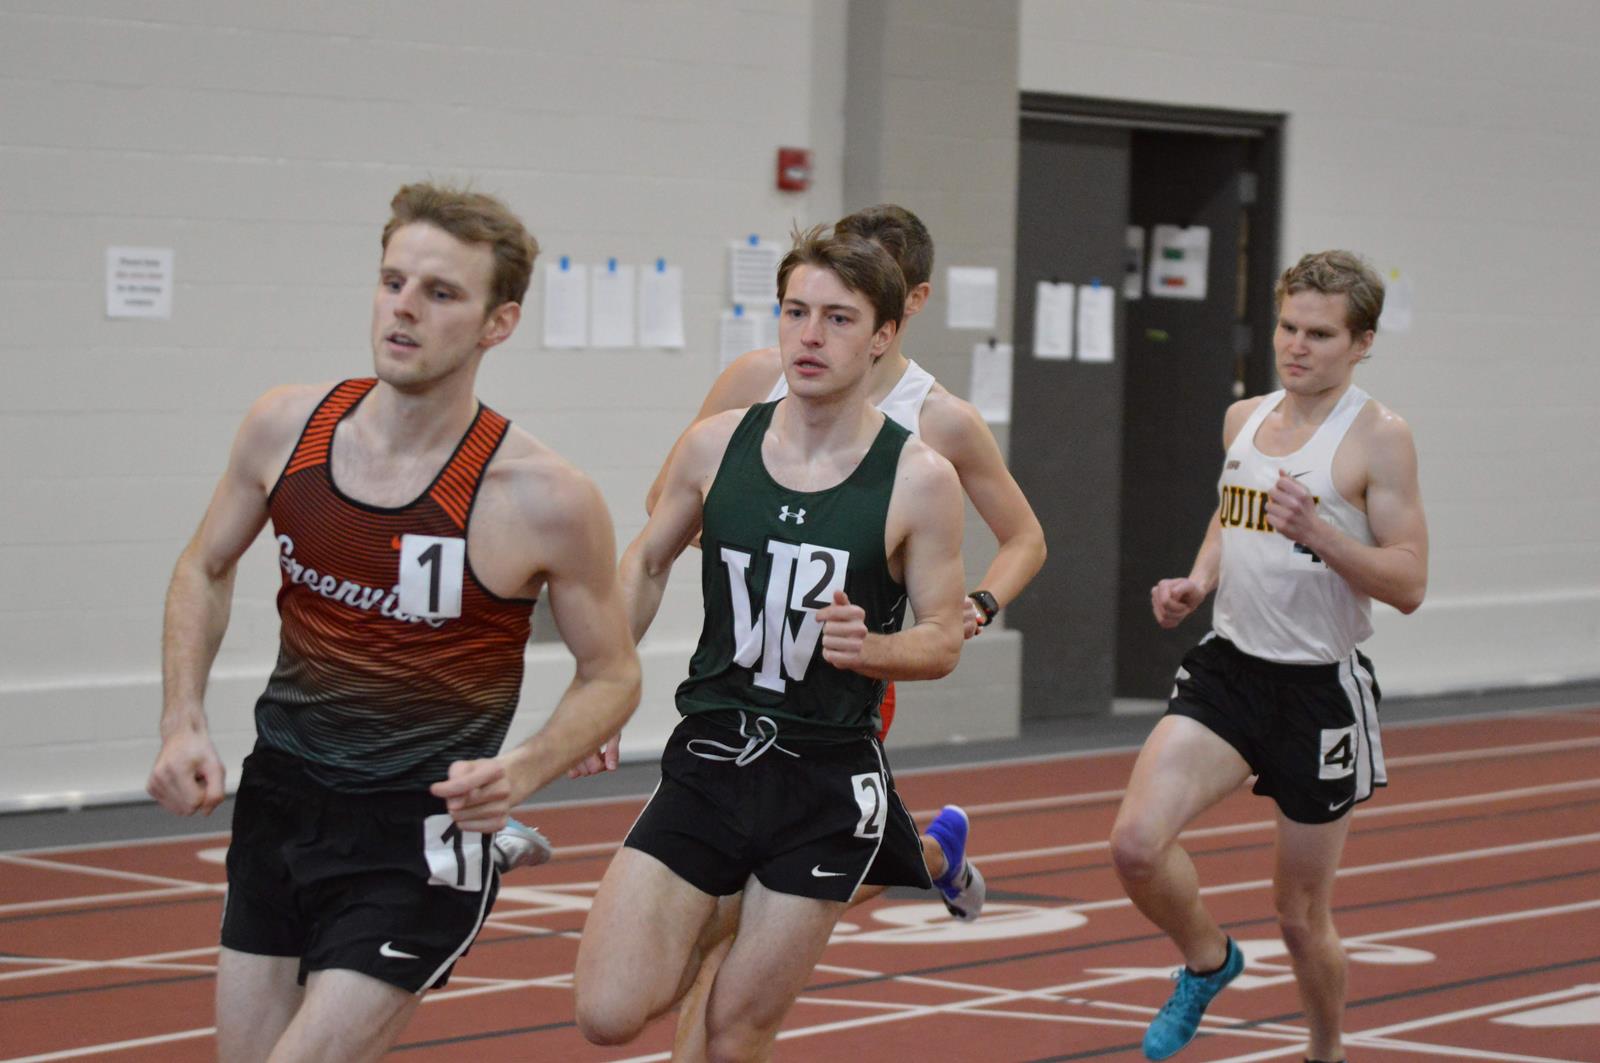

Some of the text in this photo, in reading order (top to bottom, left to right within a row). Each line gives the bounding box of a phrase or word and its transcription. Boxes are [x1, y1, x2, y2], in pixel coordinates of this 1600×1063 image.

[277, 534, 448, 628] Greenvi
[417, 543, 442, 613] 1
[802, 551, 835, 610] 2
[1324, 732, 1353, 769] 4
[861, 777, 880, 834] 2
[441, 820, 465, 886] 1
